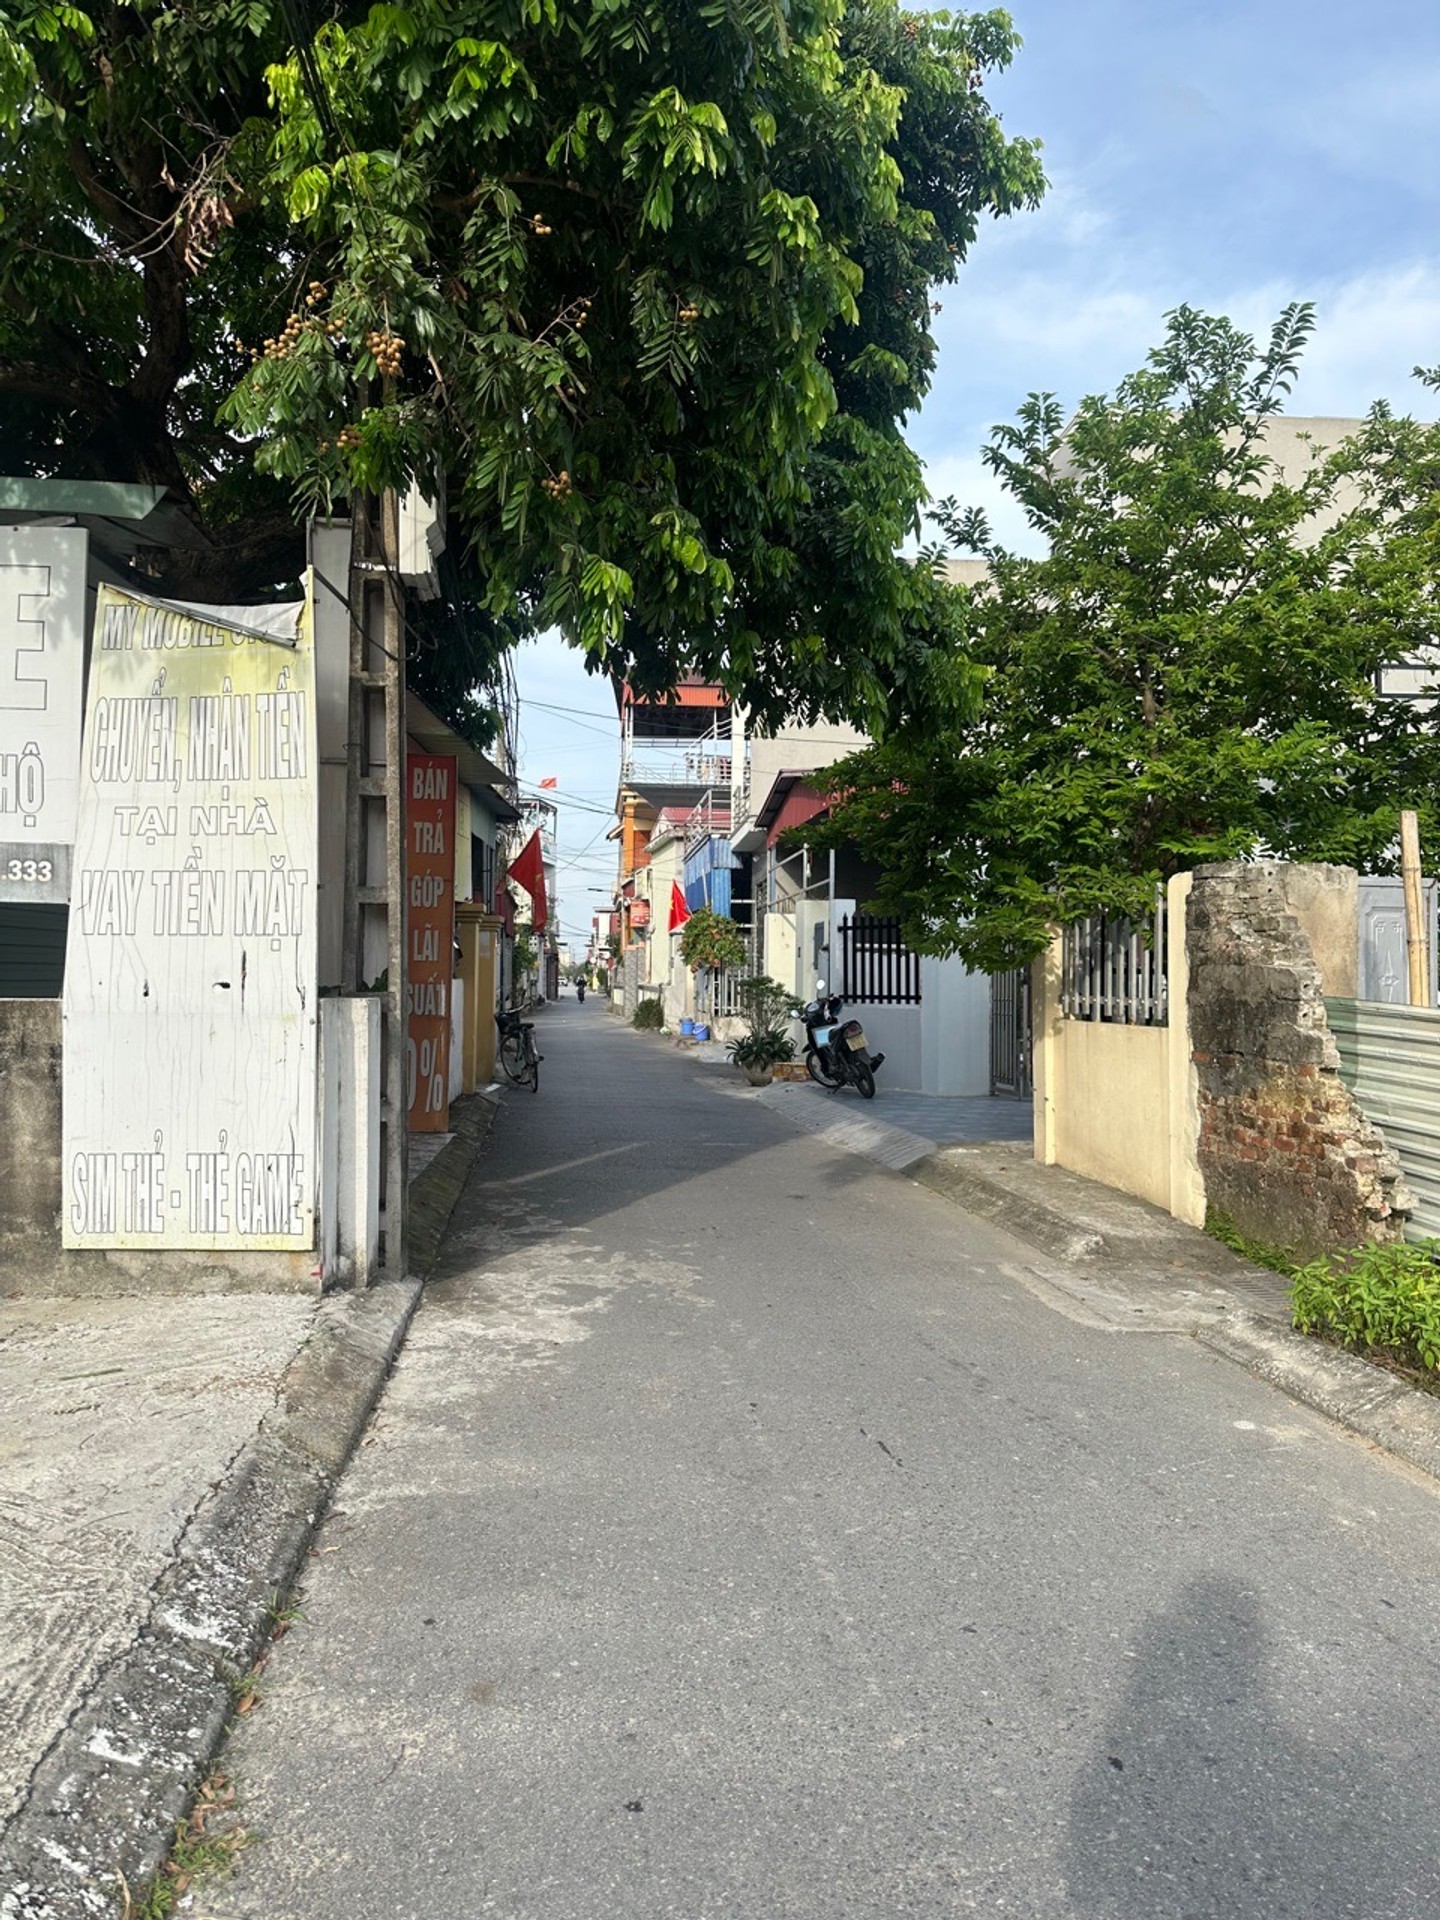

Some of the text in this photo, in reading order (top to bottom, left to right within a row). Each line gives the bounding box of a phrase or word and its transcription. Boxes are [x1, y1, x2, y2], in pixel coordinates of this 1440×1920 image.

[0, 565, 51, 710] E
[90, 665, 307, 801] CHUYỂN, NHẬN TIỀN
[412, 761, 448, 800] BÁN
[114, 796, 277, 846] TẠI NHÀ
[413, 808, 445, 854] TRẢ
[81, 845, 308, 951] VAY TIỀN MẶT
[411, 868, 444, 908] GÓP
[413, 922, 440, 961] LÃI
[71, 1151, 116, 1235] SIM
[121, 1128, 165, 1234] THẺ
[186, 1128, 230, 1234] THẺ
[235, 1152, 304, 1236] GAME
